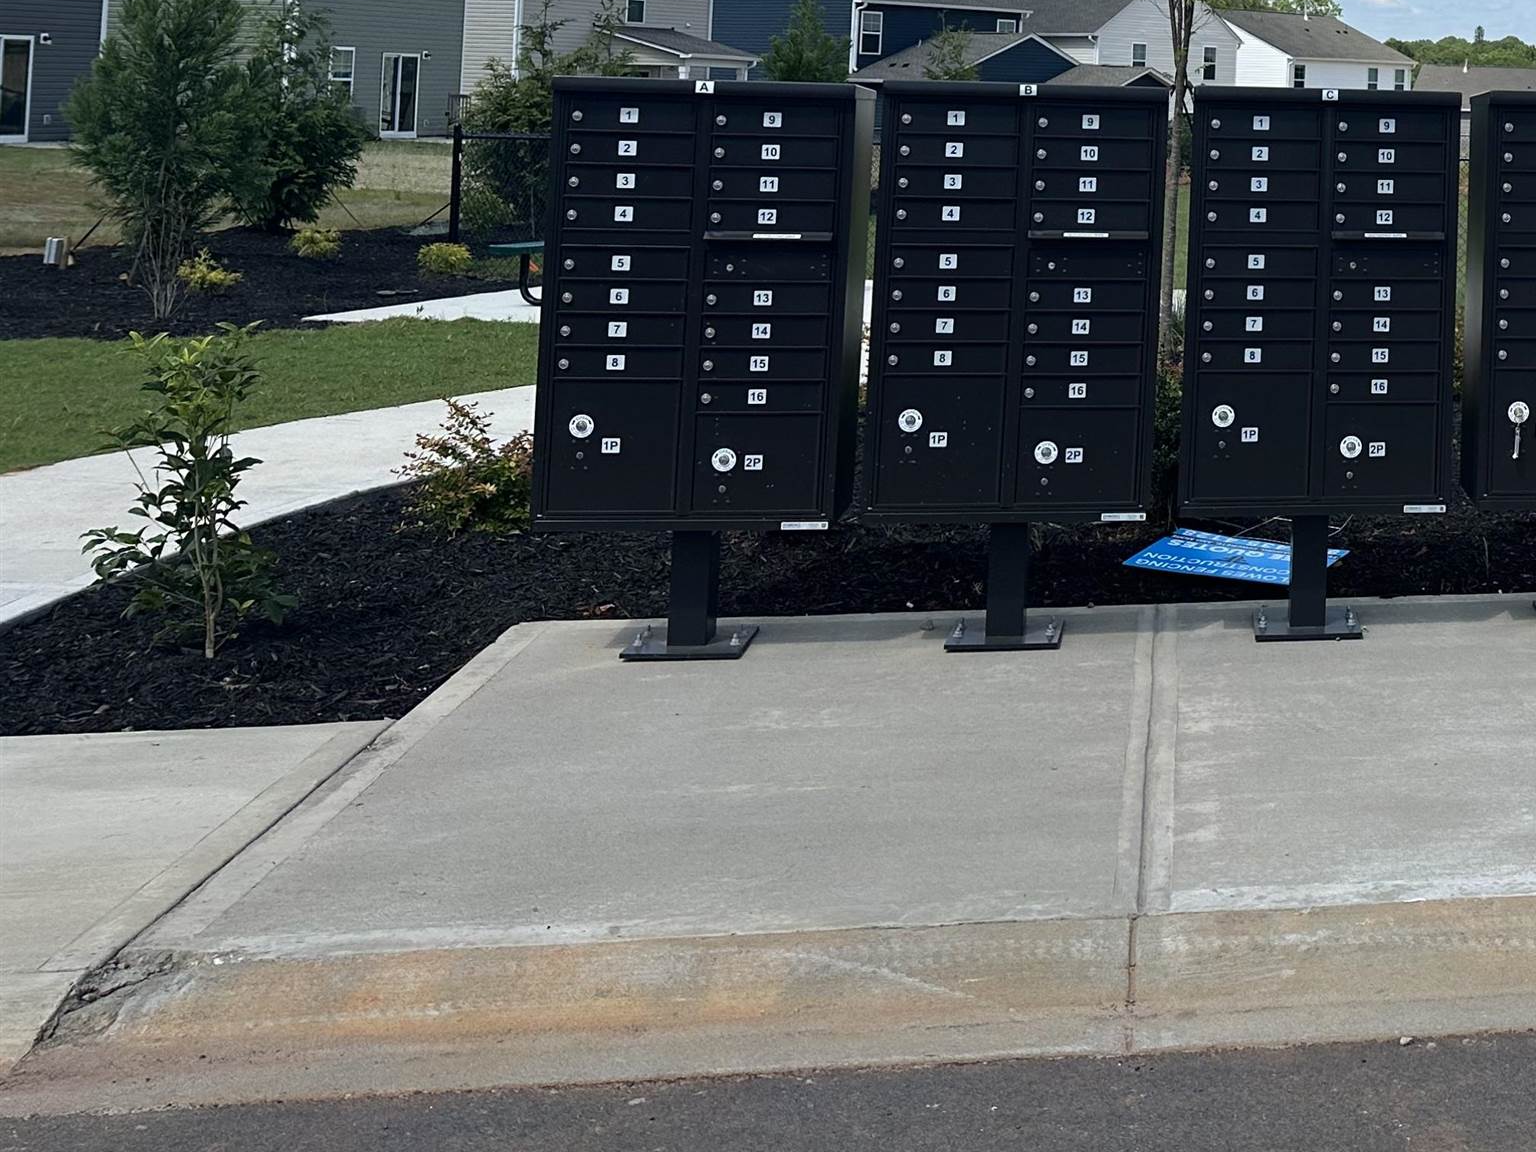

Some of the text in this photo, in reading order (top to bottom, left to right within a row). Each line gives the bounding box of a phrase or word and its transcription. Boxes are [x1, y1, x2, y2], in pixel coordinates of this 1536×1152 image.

[764, 146, 778, 157] 10
[1082, 148, 1096, 159] 10
[1380, 151, 1393, 161] 10
[762, 179, 775, 190] 11
[1081, 179, 1093, 190] 11
[1379, 181, 1391, 192] 11
[759, 211, 774, 222] 12
[1079, 211, 1093, 221] 12
[1378, 212, 1391, 223] 12
[755, 293, 770, 304] 13
[1075, 290, 1089, 301] 13
[1376, 288, 1389, 299] 13
[1074, 321, 1087, 332] 14
[1375, 319, 1388, 330] 14
[754, 326, 768, 336] 14
[1072, 353, 1086, 364] 15
[1374, 350, 1387, 361] 15
[752, 358, 766, 369] 15
[1071, 385, 1084, 396] 16
[1373, 381, 1386, 392] 16
[750, 391, 764, 402] 16
[931, 434, 946, 445] 1P
[1242, 429, 1257, 440] 1P
[603, 440, 619, 451] 1P
[1370, 444, 1384, 455] 2P
[1066, 450, 1081, 461] 2P
[745, 457, 762, 468] 2P
[1168, 539, 1265, 558] QUOTES
[1135, 558, 1218, 575] FENCING
[1143, 552, 1290, 576] CONSTRUCTION
